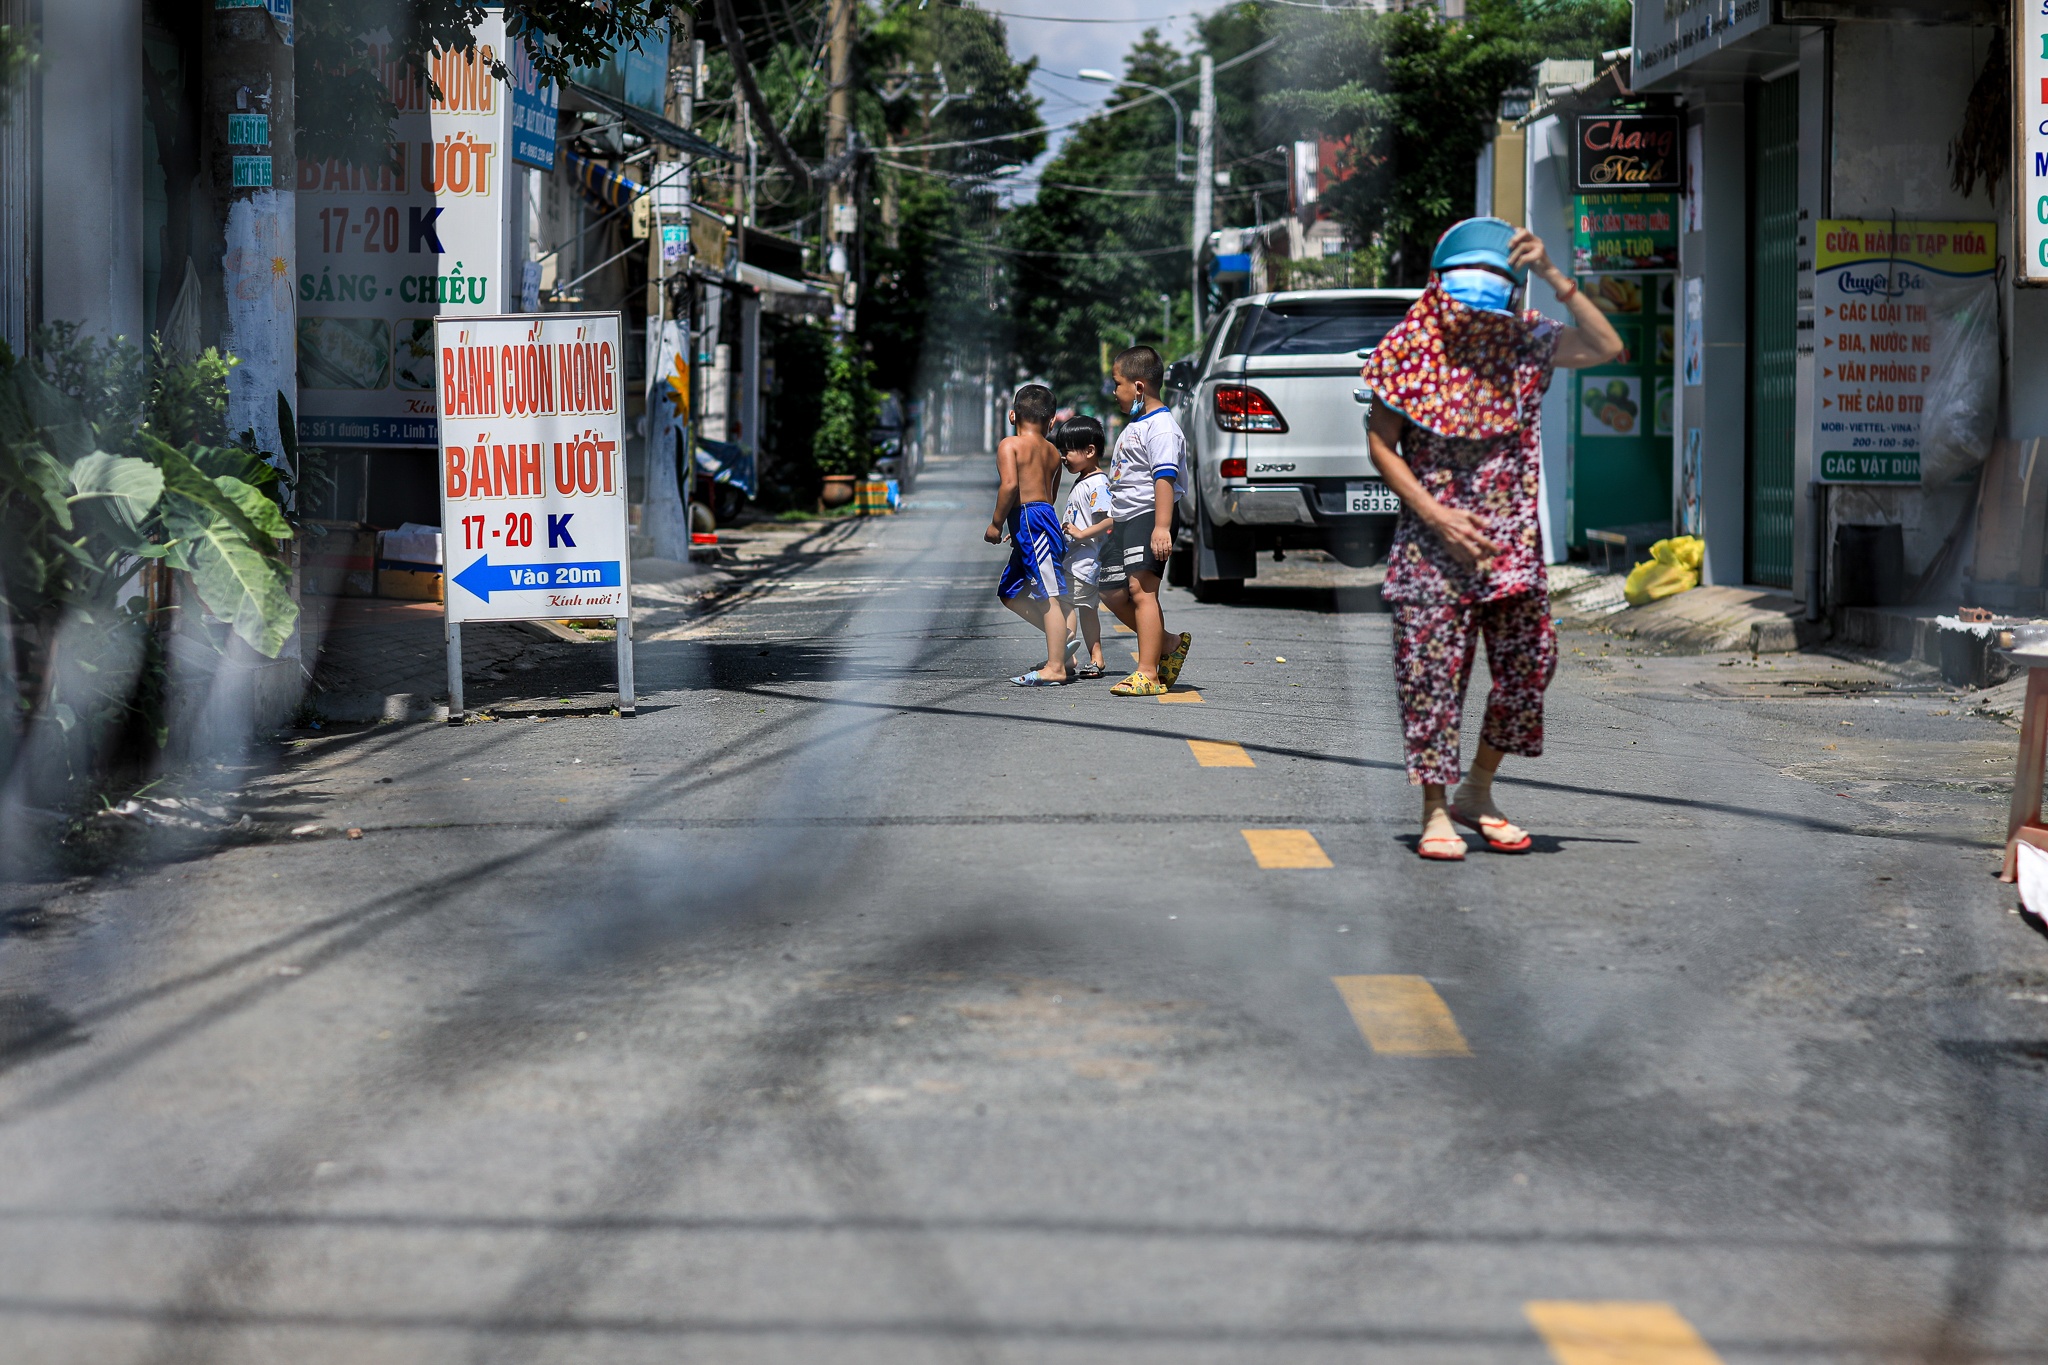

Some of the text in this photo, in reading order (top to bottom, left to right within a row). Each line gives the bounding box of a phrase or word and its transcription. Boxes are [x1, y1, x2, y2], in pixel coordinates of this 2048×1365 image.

[1584, 120, 1673, 157] Chang
[420, 131, 492, 193] ƯỚT
[1590, 155, 1664, 184] Nails
[408, 206, 446, 254] K
[1597, 239, 1622, 257] HOA
[1825, 227, 1987, 258] CỬA HÀNG TẠP HÓA
[299, 265, 378, 302] SÁNG
[399, 260, 488, 305] CHIỀU
[1838, 271, 1895, 296] Chuyên
[1839, 303, 1867, 322] CÁC
[1871, 303, 1901, 327] LOẠI
[1838, 334, 1866, 354] BIA,
[1870, 332, 1908, 352] NƯỚC
[442, 320, 614, 416] BÁNH CUỐN NÓNG
[1838, 361, 1867, 383] VĂN
[1870, 361, 1917, 383] PHÒNG
[1837, 389, 1862, 413] THẺ
[1866, 391, 1894, 413] CÀO
[312, 420, 327, 436] Số
[330, 422, 335, 436] 1
[372, 423, 380, 438] 5
[389, 424, 401, 438] P.
[403, 424, 426, 438] Linh
[1821, 422, 1844, 431] MOBI
[1849, 422, 1886, 432] VIETTEL
[1890, 423, 1912, 433] VINA
[1852, 437, 1871, 447] 200
[1878, 438, 1896, 447] 100
[445, 429, 616, 498] BÁNH ƯỚT
[1825, 454, 1857, 474] CÁC
[1860, 454, 1888, 478] VẬT
[1363, 483, 1390, 497] 51D
[1352, 498, 1400, 511] 683.62
[547, 513, 577, 548] K
[509, 567, 601, 586] Vào 20m
[545, 594, 582, 607] Kính
[586, 593, 612, 606] mời
